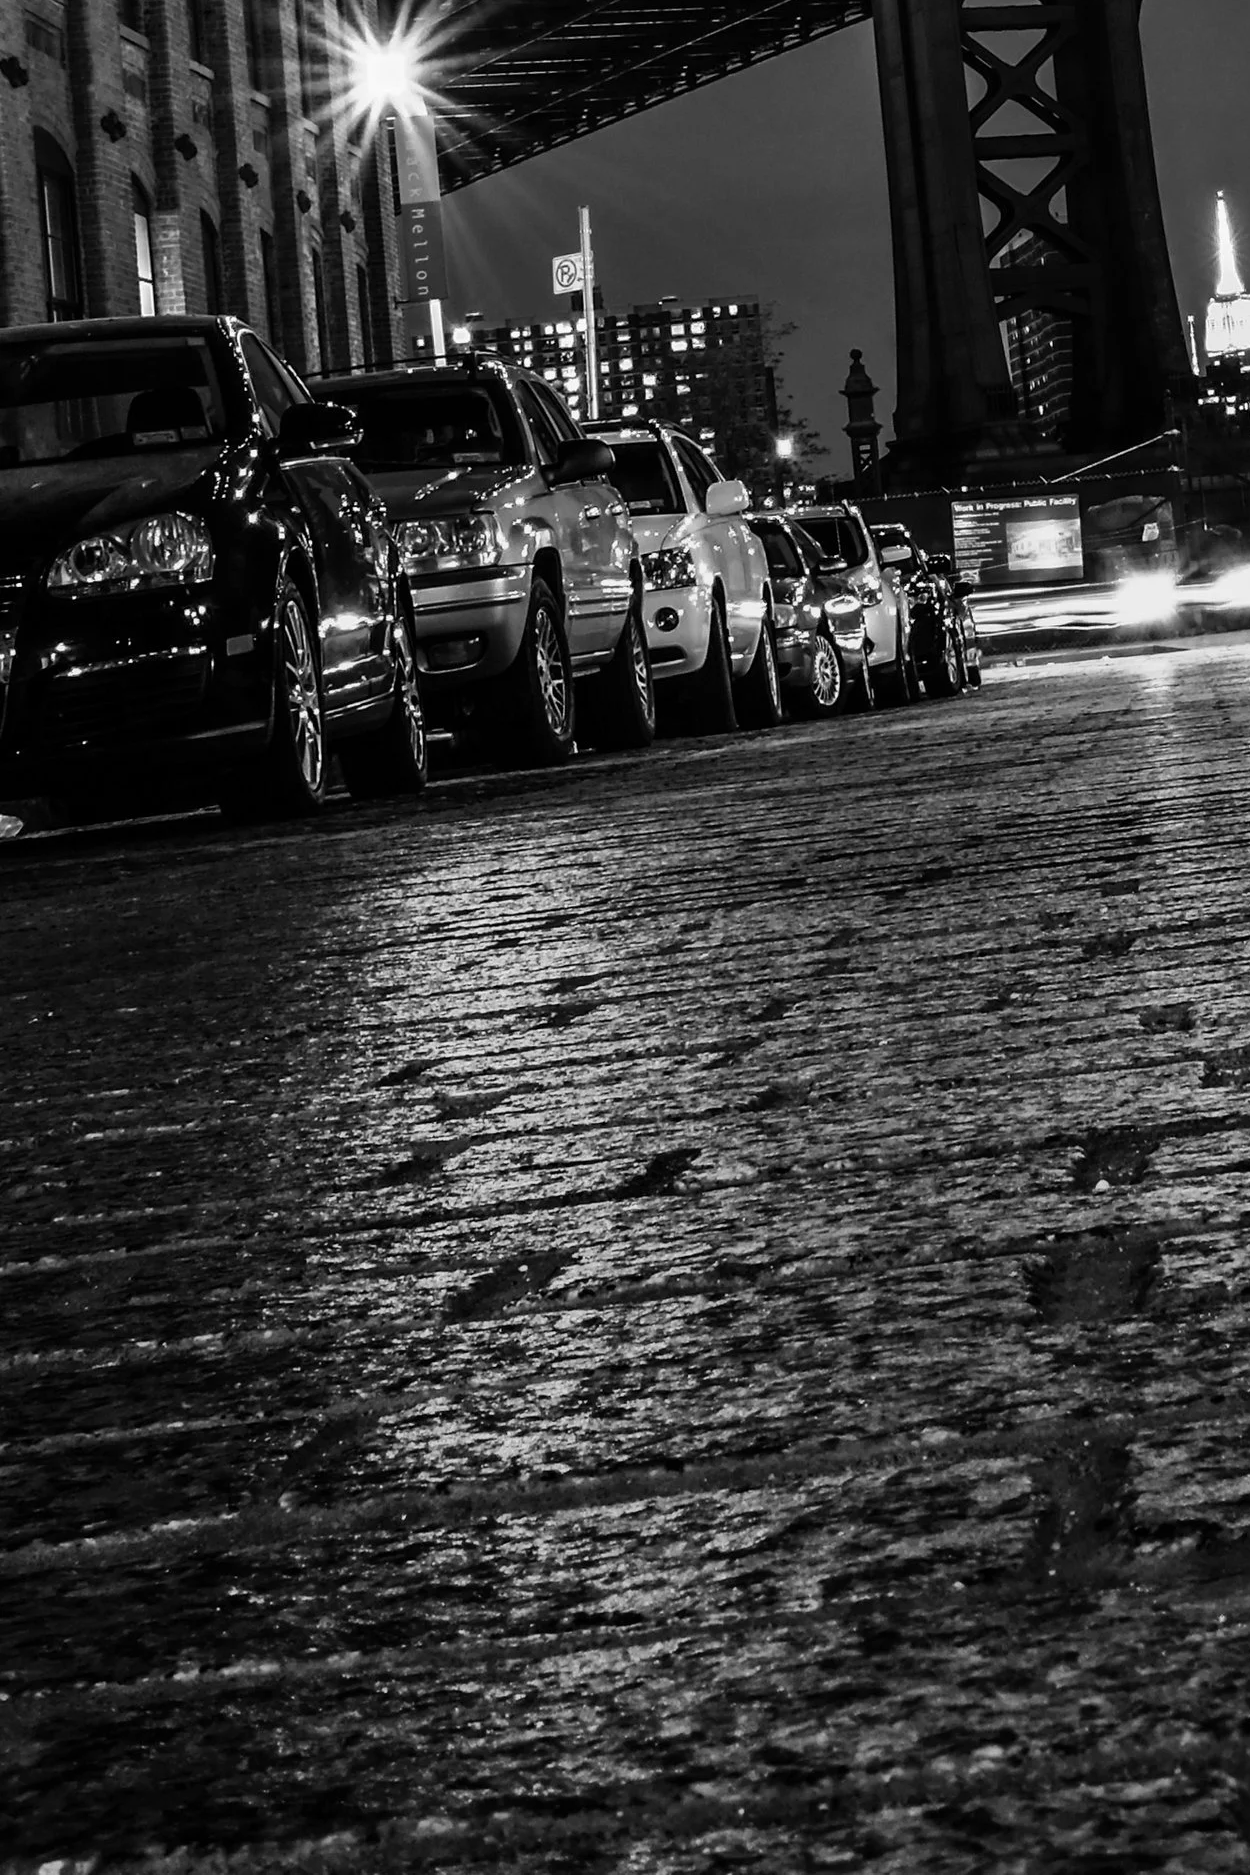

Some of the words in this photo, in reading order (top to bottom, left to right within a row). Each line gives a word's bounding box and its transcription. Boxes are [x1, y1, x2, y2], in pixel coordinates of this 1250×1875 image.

[411, 208, 430, 296] Mellon
[1023, 499, 1047, 507] Public
[1049, 497, 1077, 506] Facility
